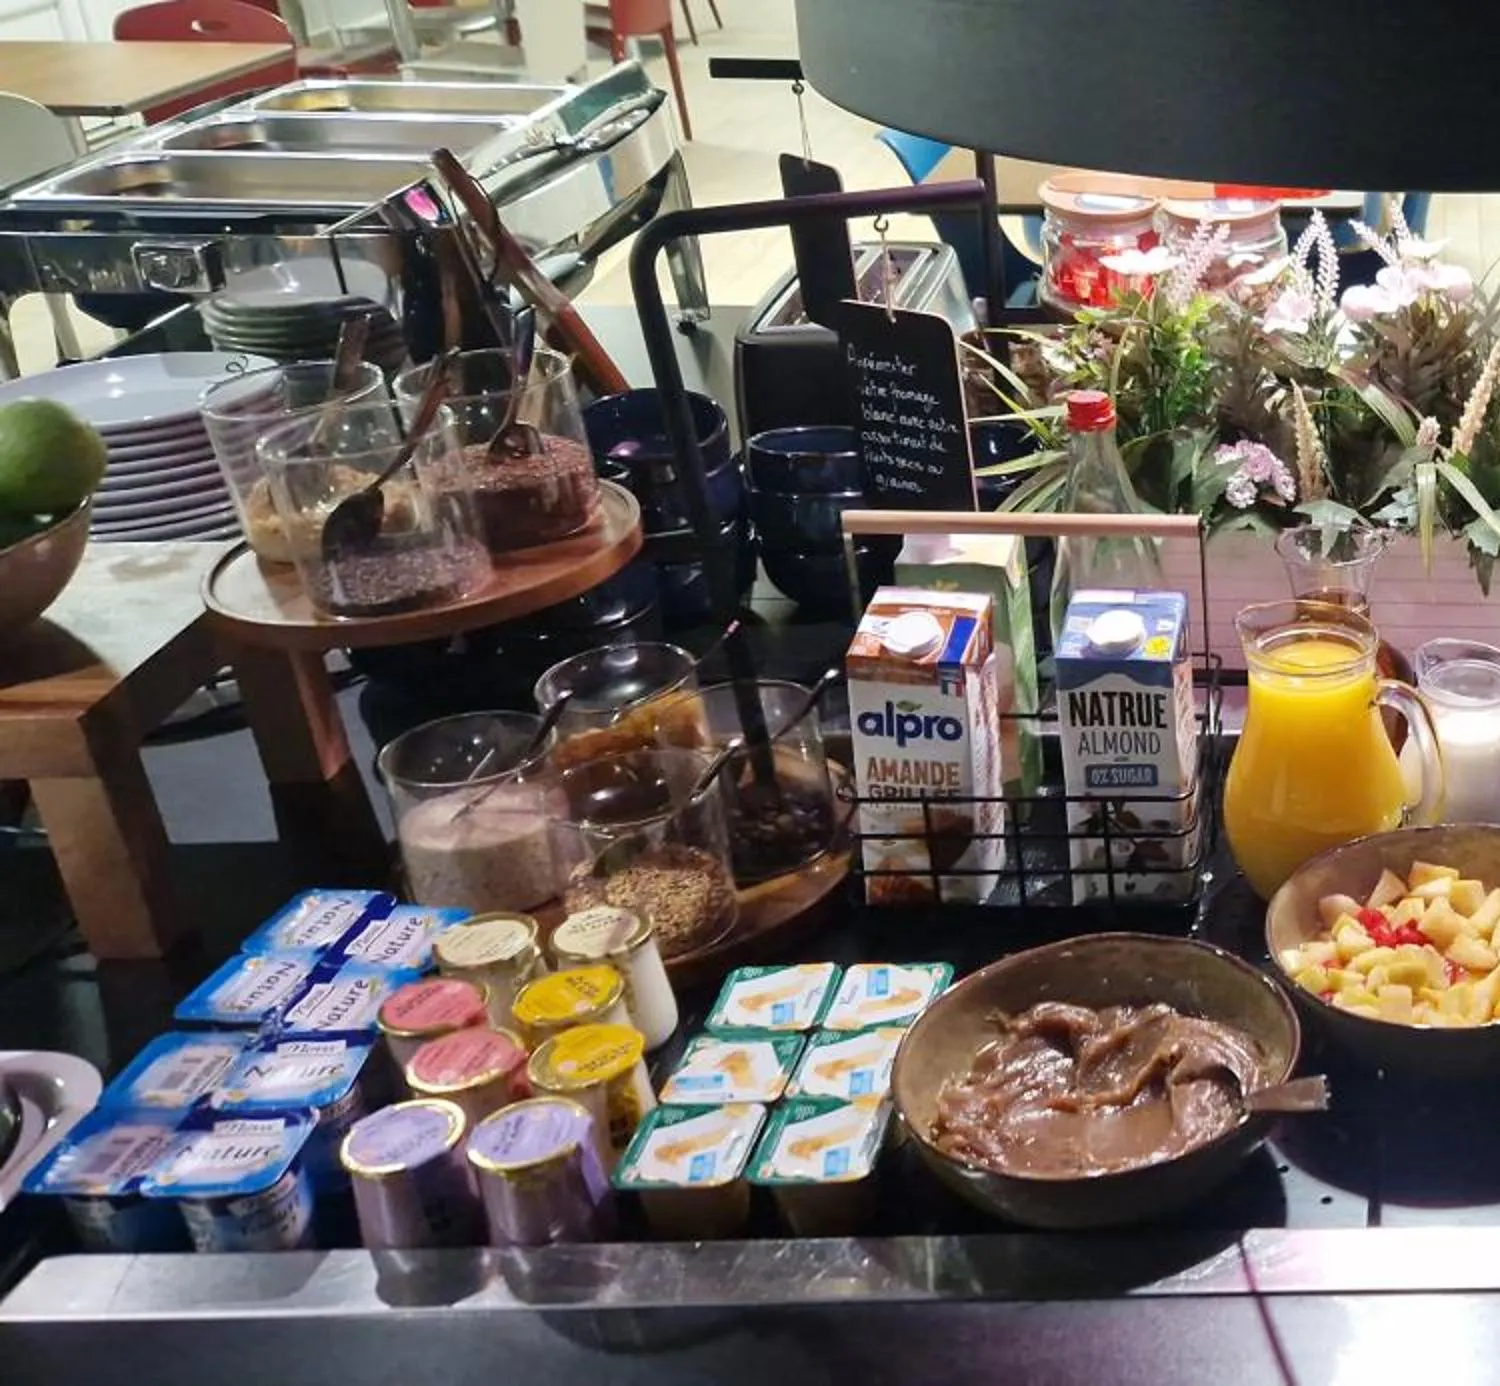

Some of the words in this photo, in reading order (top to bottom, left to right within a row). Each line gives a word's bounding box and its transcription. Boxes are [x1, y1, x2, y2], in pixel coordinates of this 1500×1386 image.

[857, 701, 963, 748] alpro
[1068, 691, 1168, 729] NATRUE
[1078, 731, 1161, 756] ALMOND
[866, 756, 960, 787] AMANDE
[1091, 766, 1110, 785] 0%
[1111, 766, 1154, 785] SUGAR
